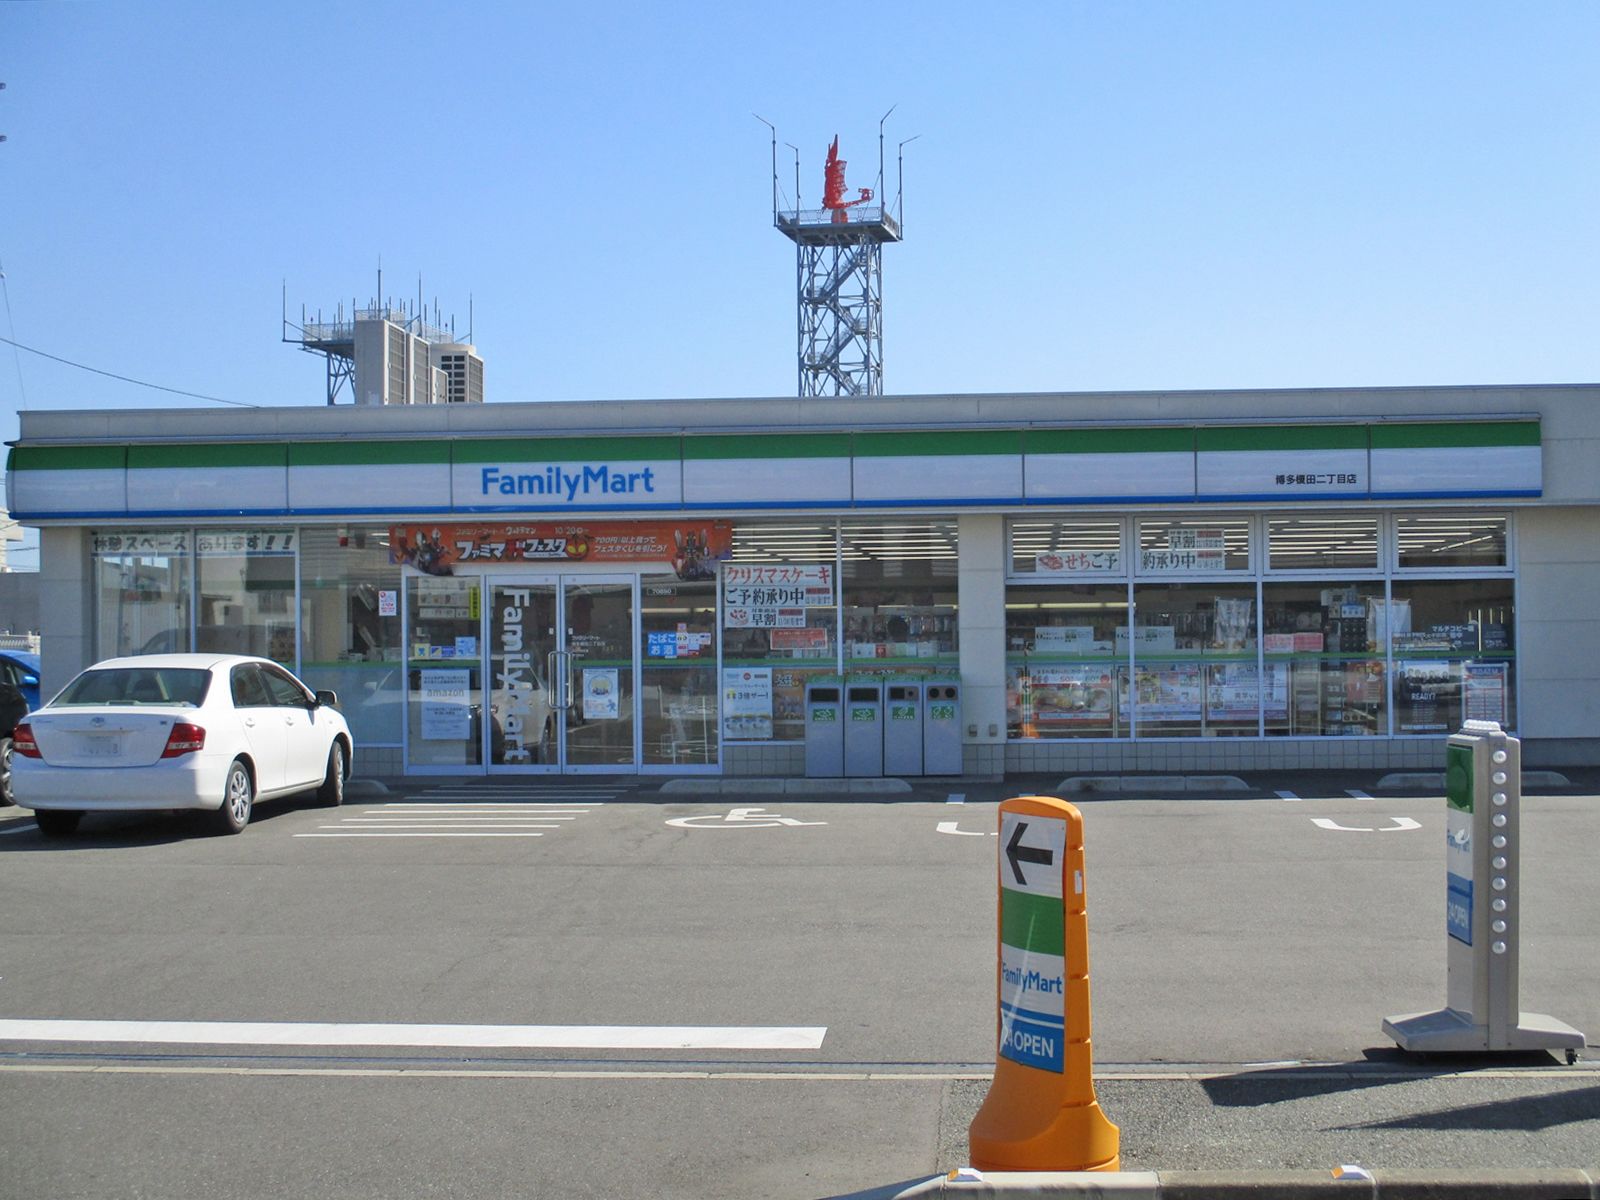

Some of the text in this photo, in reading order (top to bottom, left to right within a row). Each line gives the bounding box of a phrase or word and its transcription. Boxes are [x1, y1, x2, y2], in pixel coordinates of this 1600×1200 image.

[481, 465, 655, 502] FamilyMart
[726, 566, 831, 585] クリスマスケーキ
[726, 587, 805, 606] ご予約承り中
[752, 613, 777, 626] 早割
[648, 633, 677, 644] たばこ
[496, 588, 531, 761] FamilyMart
[427, 688, 465, 697] amazon
[1002, 962, 1063, 995] FamilyMart
